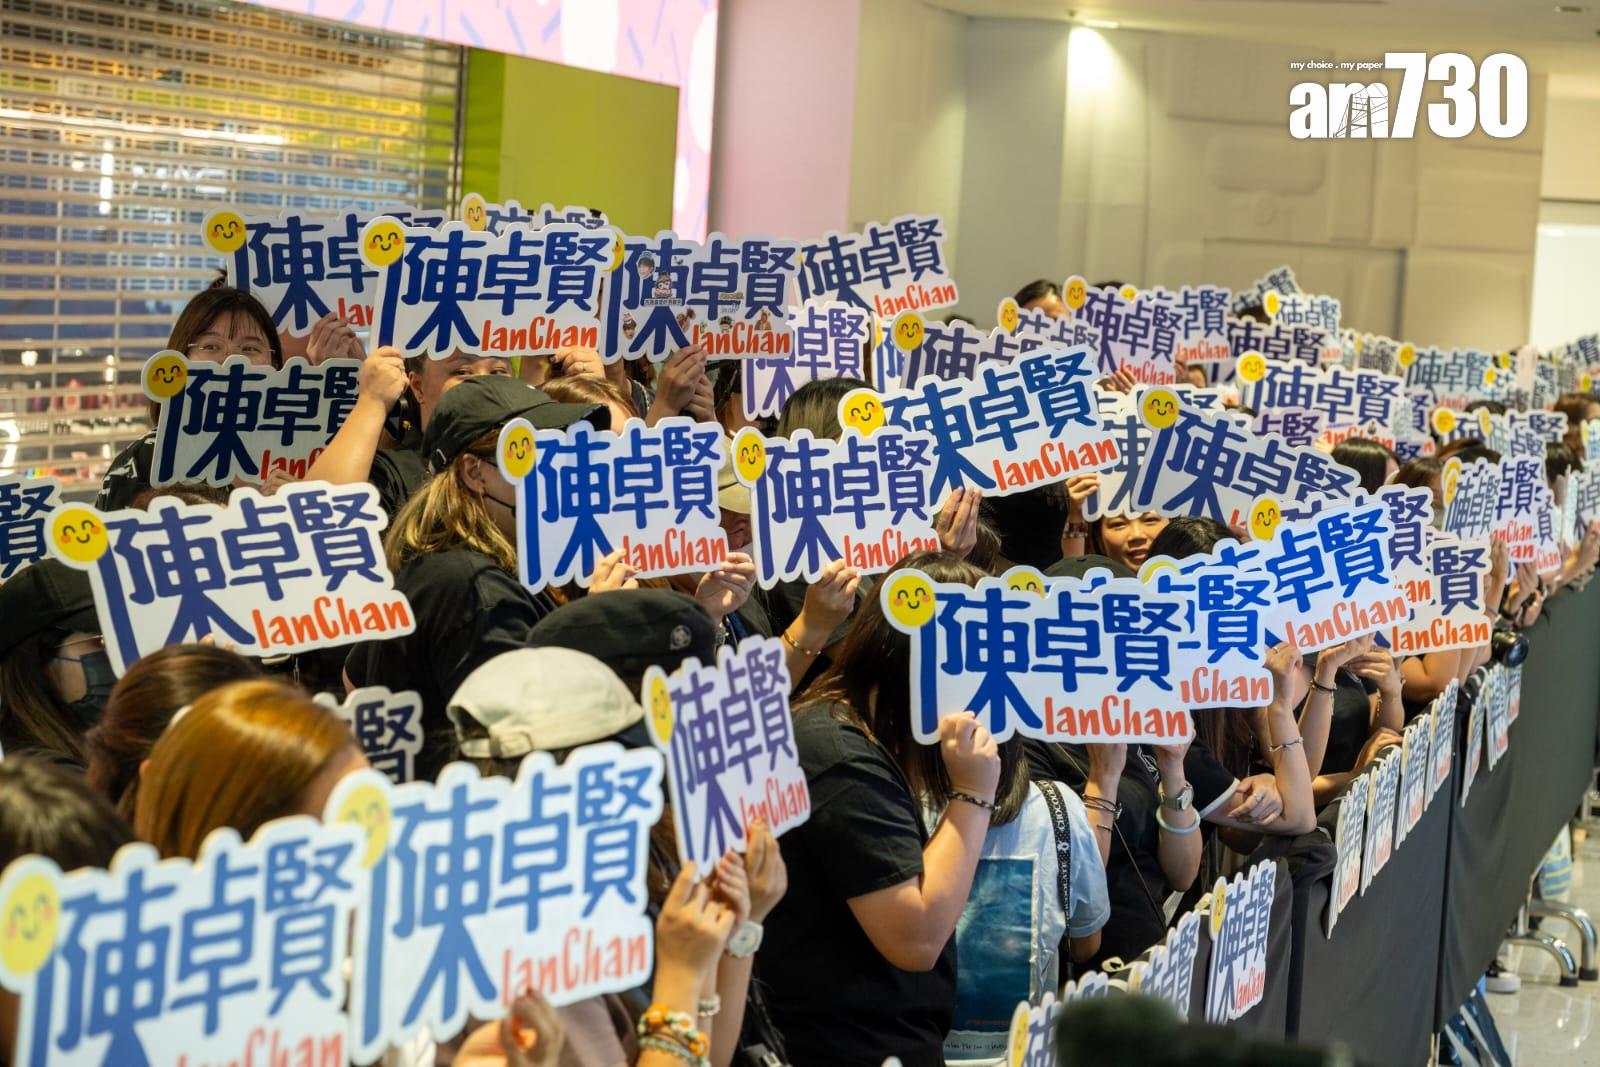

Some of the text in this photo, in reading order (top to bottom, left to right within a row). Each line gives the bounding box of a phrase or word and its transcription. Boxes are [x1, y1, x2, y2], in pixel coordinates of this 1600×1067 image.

[378, 229, 610, 352] 陳卓賢
[605, 238, 796, 358] 陳卓賢
[800, 218, 945, 314] 陳卓賢
[874, 282, 957, 318] IanChan
[481, 316, 597, 351] IanChan
[1078, 292, 1183, 374] 陳卓賢
[1174, 289, 1228, 340] 卓賢
[881, 352, 1098, 505] 陳卓賢
[1251, 364, 1399, 428] 陳卓賢
[524, 427, 719, 586] 陳卓賢
[754, 434, 931, 581] 陳卓賢
[993, 438, 1118, 491] IanChan
[97, 491, 385, 672] 陳卓賢
[623, 527, 726, 572] IanChan
[1264, 508, 1390, 615] 卓賢
[252, 596, 410, 649] IanChan
[920, 587, 1183, 738] 陳卓賢
[1285, 594, 1408, 648] IanChan
[1392, 617, 1489, 652] IanChan
[670, 647, 794, 863] 陳卓賢
[1044, 694, 1188, 738] IanChan
[361, 759, 654, 1047] 陳卓賢
[28, 838, 354, 1067] 陳卓賢
[502, 927, 647, 1008] IanChan
